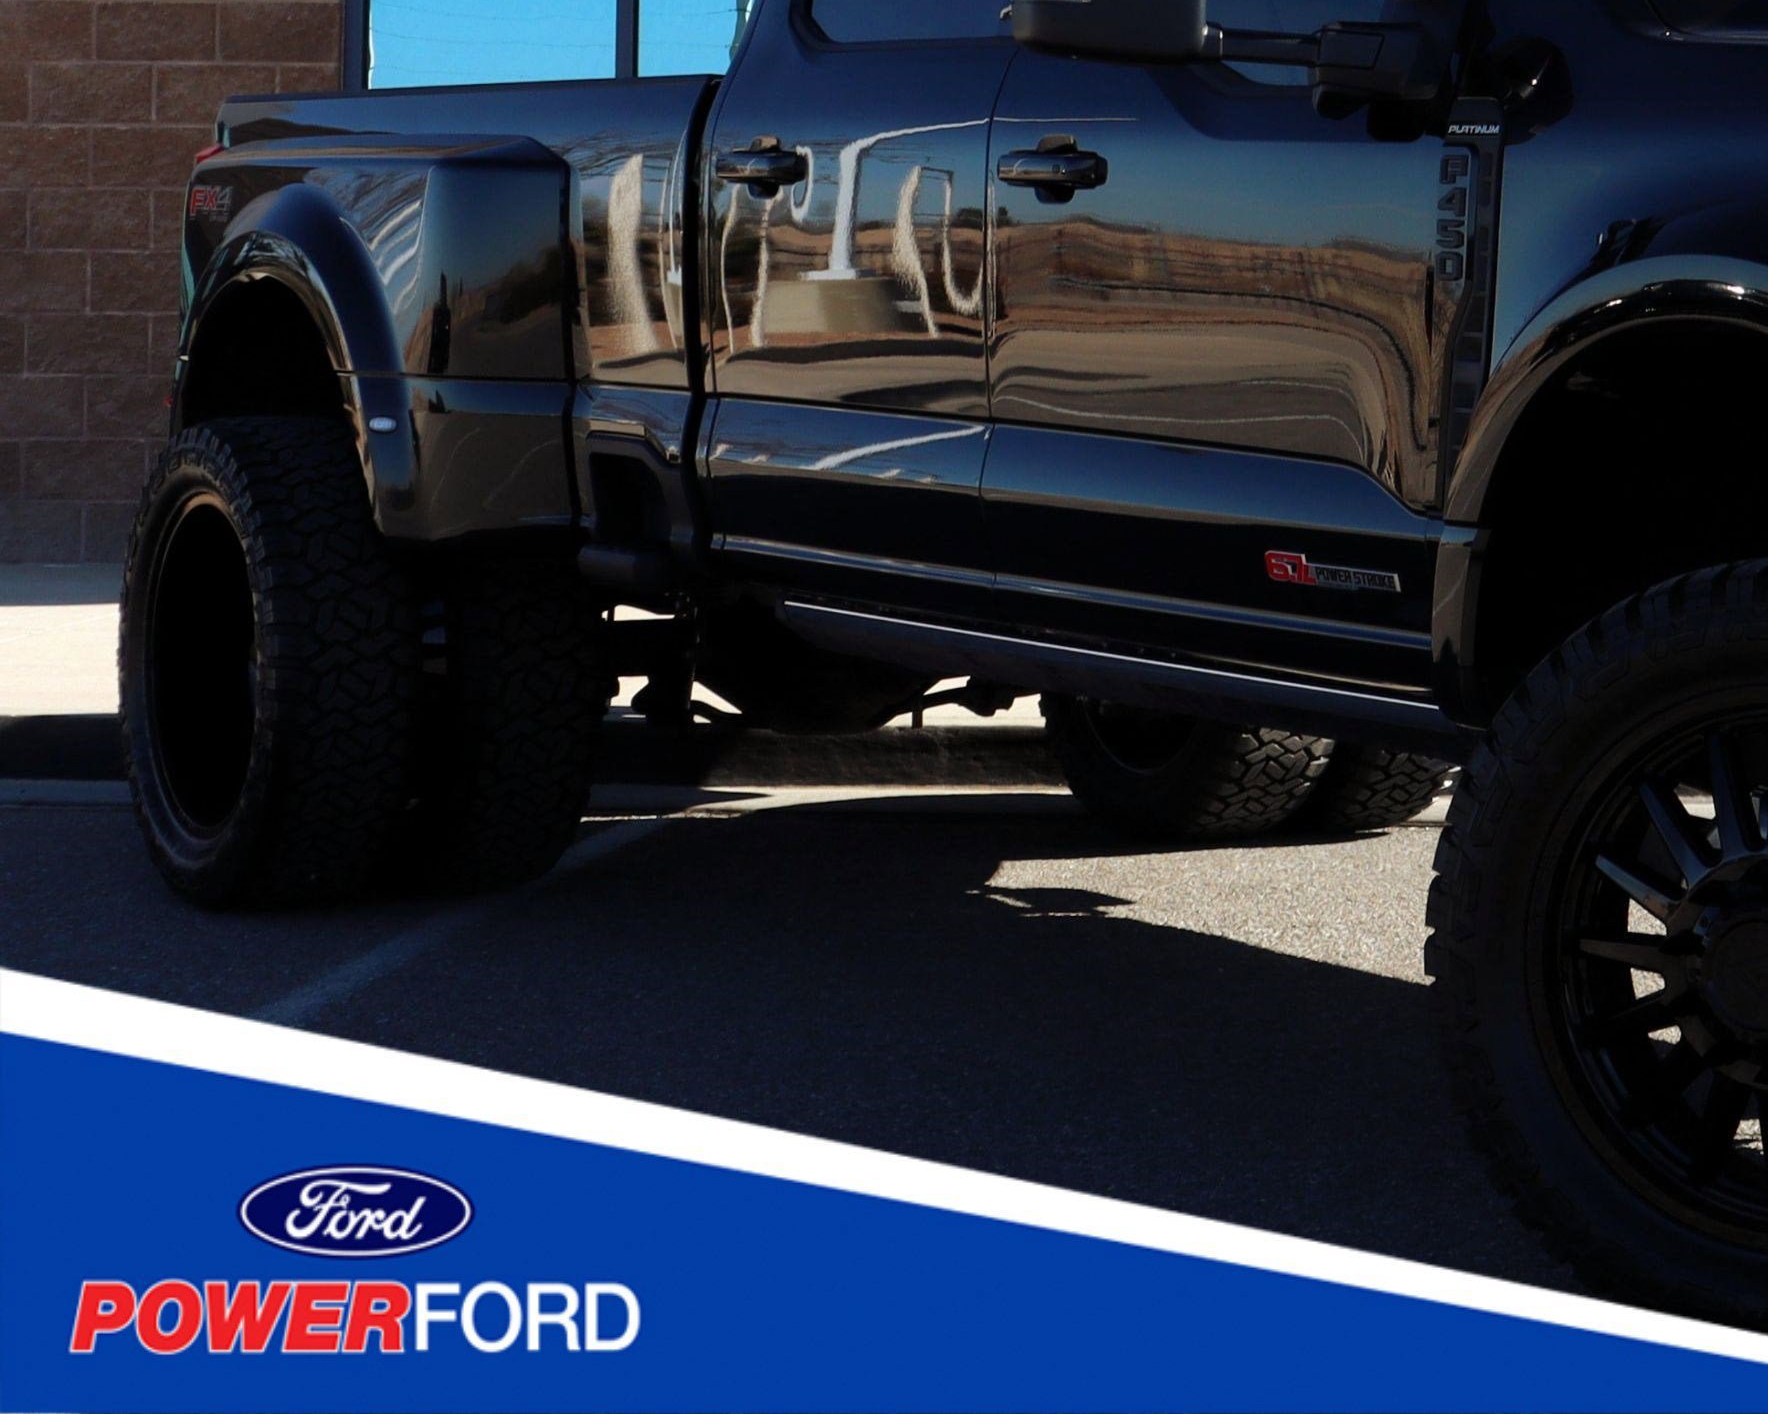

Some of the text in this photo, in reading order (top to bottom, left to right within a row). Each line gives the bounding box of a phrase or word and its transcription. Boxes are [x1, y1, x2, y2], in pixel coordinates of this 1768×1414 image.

[1448, 124, 1500, 135] PLATINUM
[189, 187, 235, 218] FX4
[1315, 566, 1351, 584] POWER
